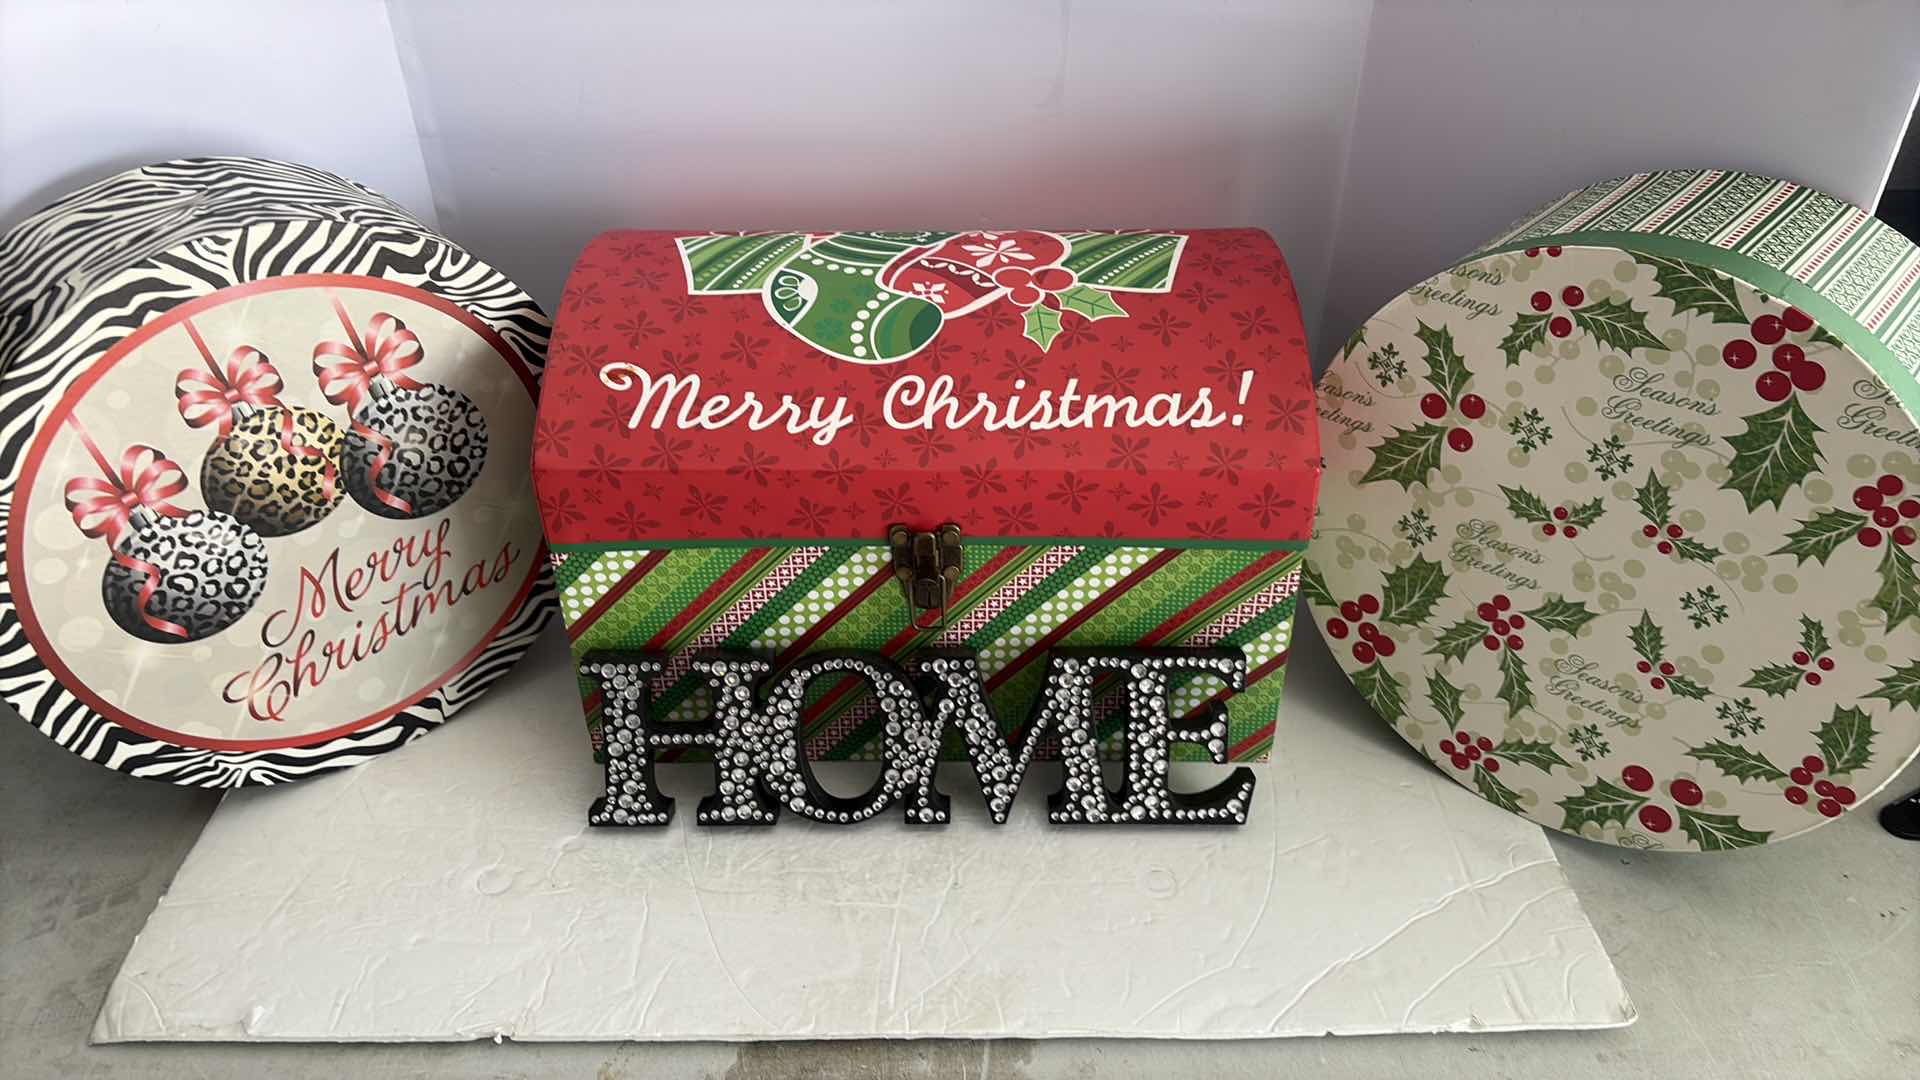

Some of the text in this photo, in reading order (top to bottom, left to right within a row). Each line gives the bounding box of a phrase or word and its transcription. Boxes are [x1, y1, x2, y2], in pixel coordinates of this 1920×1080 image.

[599, 362, 1254, 445] Merry Christmas!
[1315, 370, 1376, 407] eason's
[1613, 367, 1720, 415] Season's
[1315, 407, 1375, 435] etings
[1601, 395, 1714, 448] Greetings
[1448, 541, 1542, 591] Greetings
[1456, 518, 1544, 564] Season's
[262, 518, 450, 648] Merry
[222, 541, 520, 721] Christmas
[1545, 675, 1643, 728] Greetings
[1554, 654, 1648, 704] Season's
[580, 647, 1256, 826] HOME
